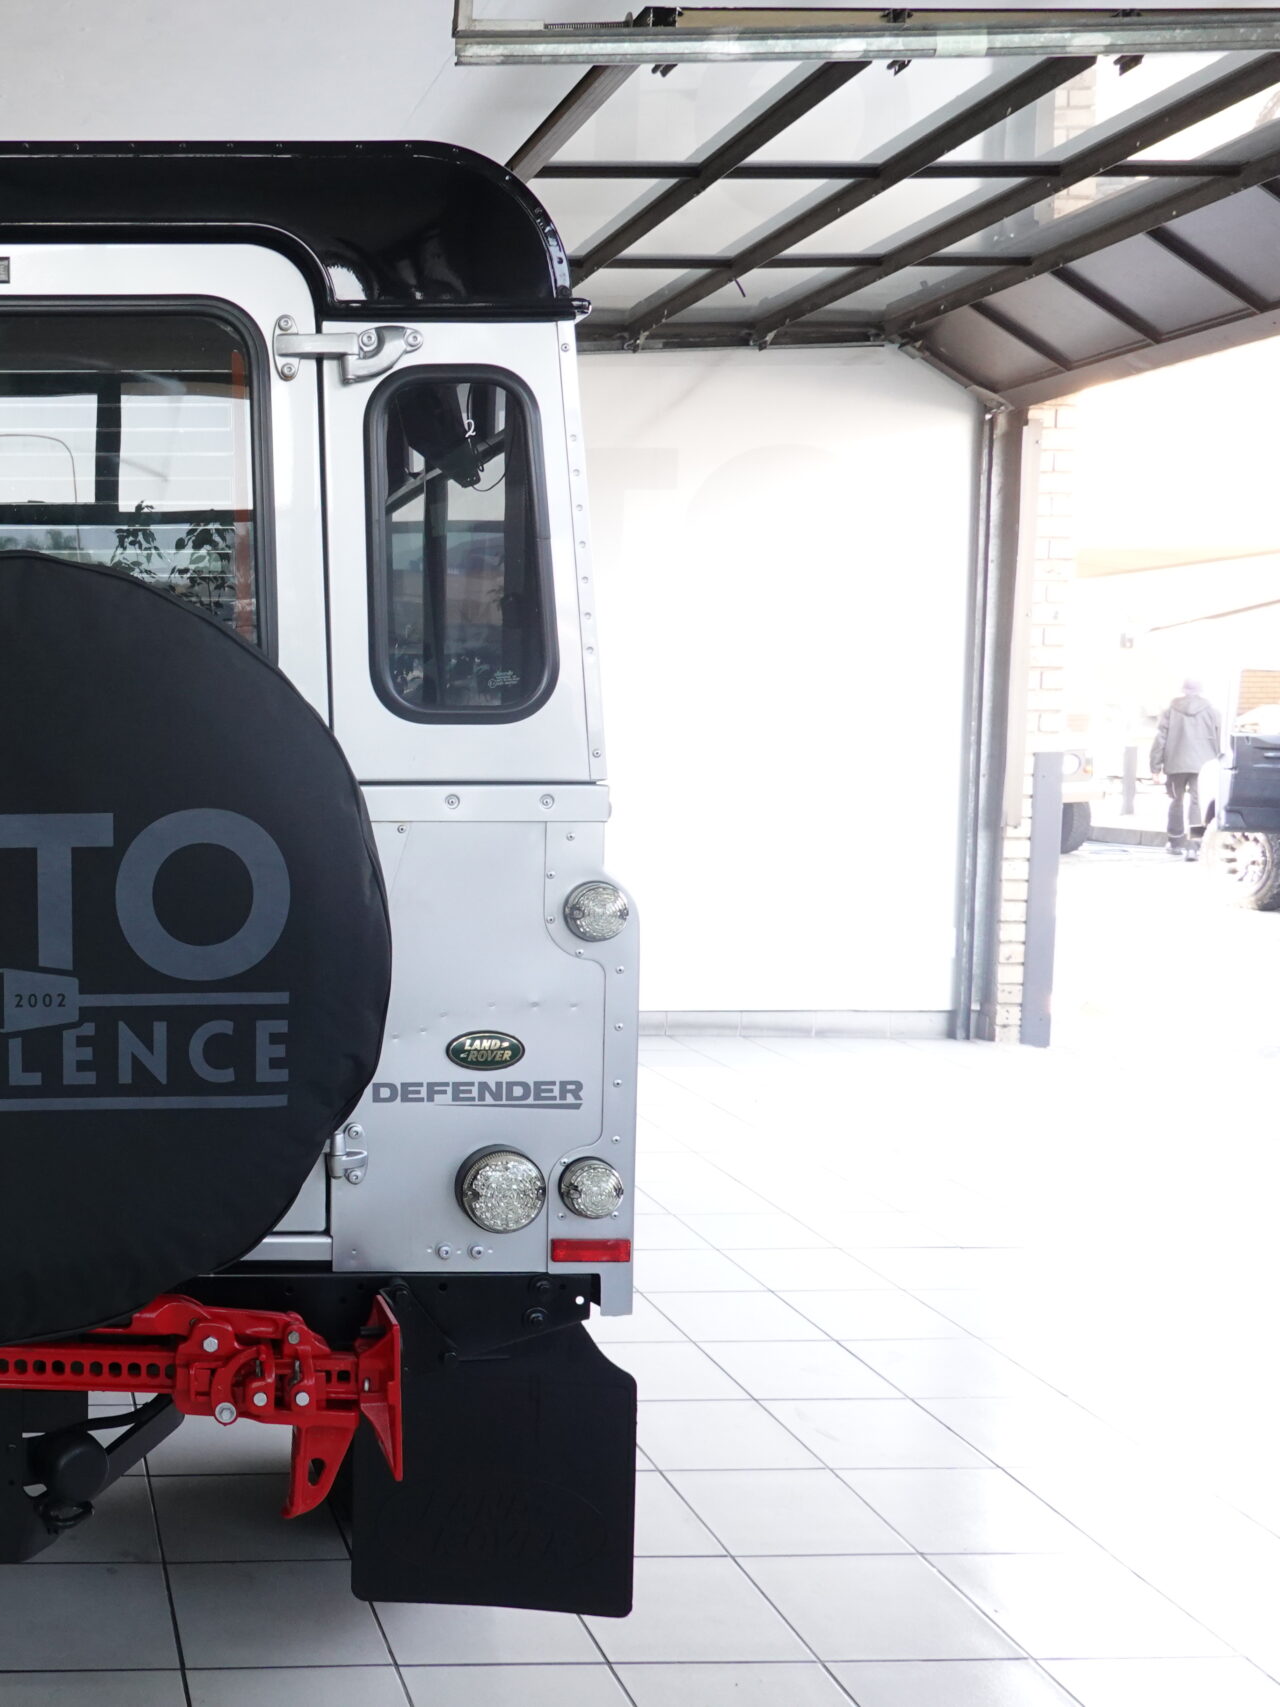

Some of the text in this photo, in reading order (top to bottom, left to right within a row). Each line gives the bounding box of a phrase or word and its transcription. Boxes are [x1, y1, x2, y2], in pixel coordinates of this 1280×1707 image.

[14, 992, 66, 1009] 2002
[464, 1039, 502, 1050] LAND
[467, 1050, 512, 1062] ROVER
[371, 1080, 584, 1103] DEFENDER
